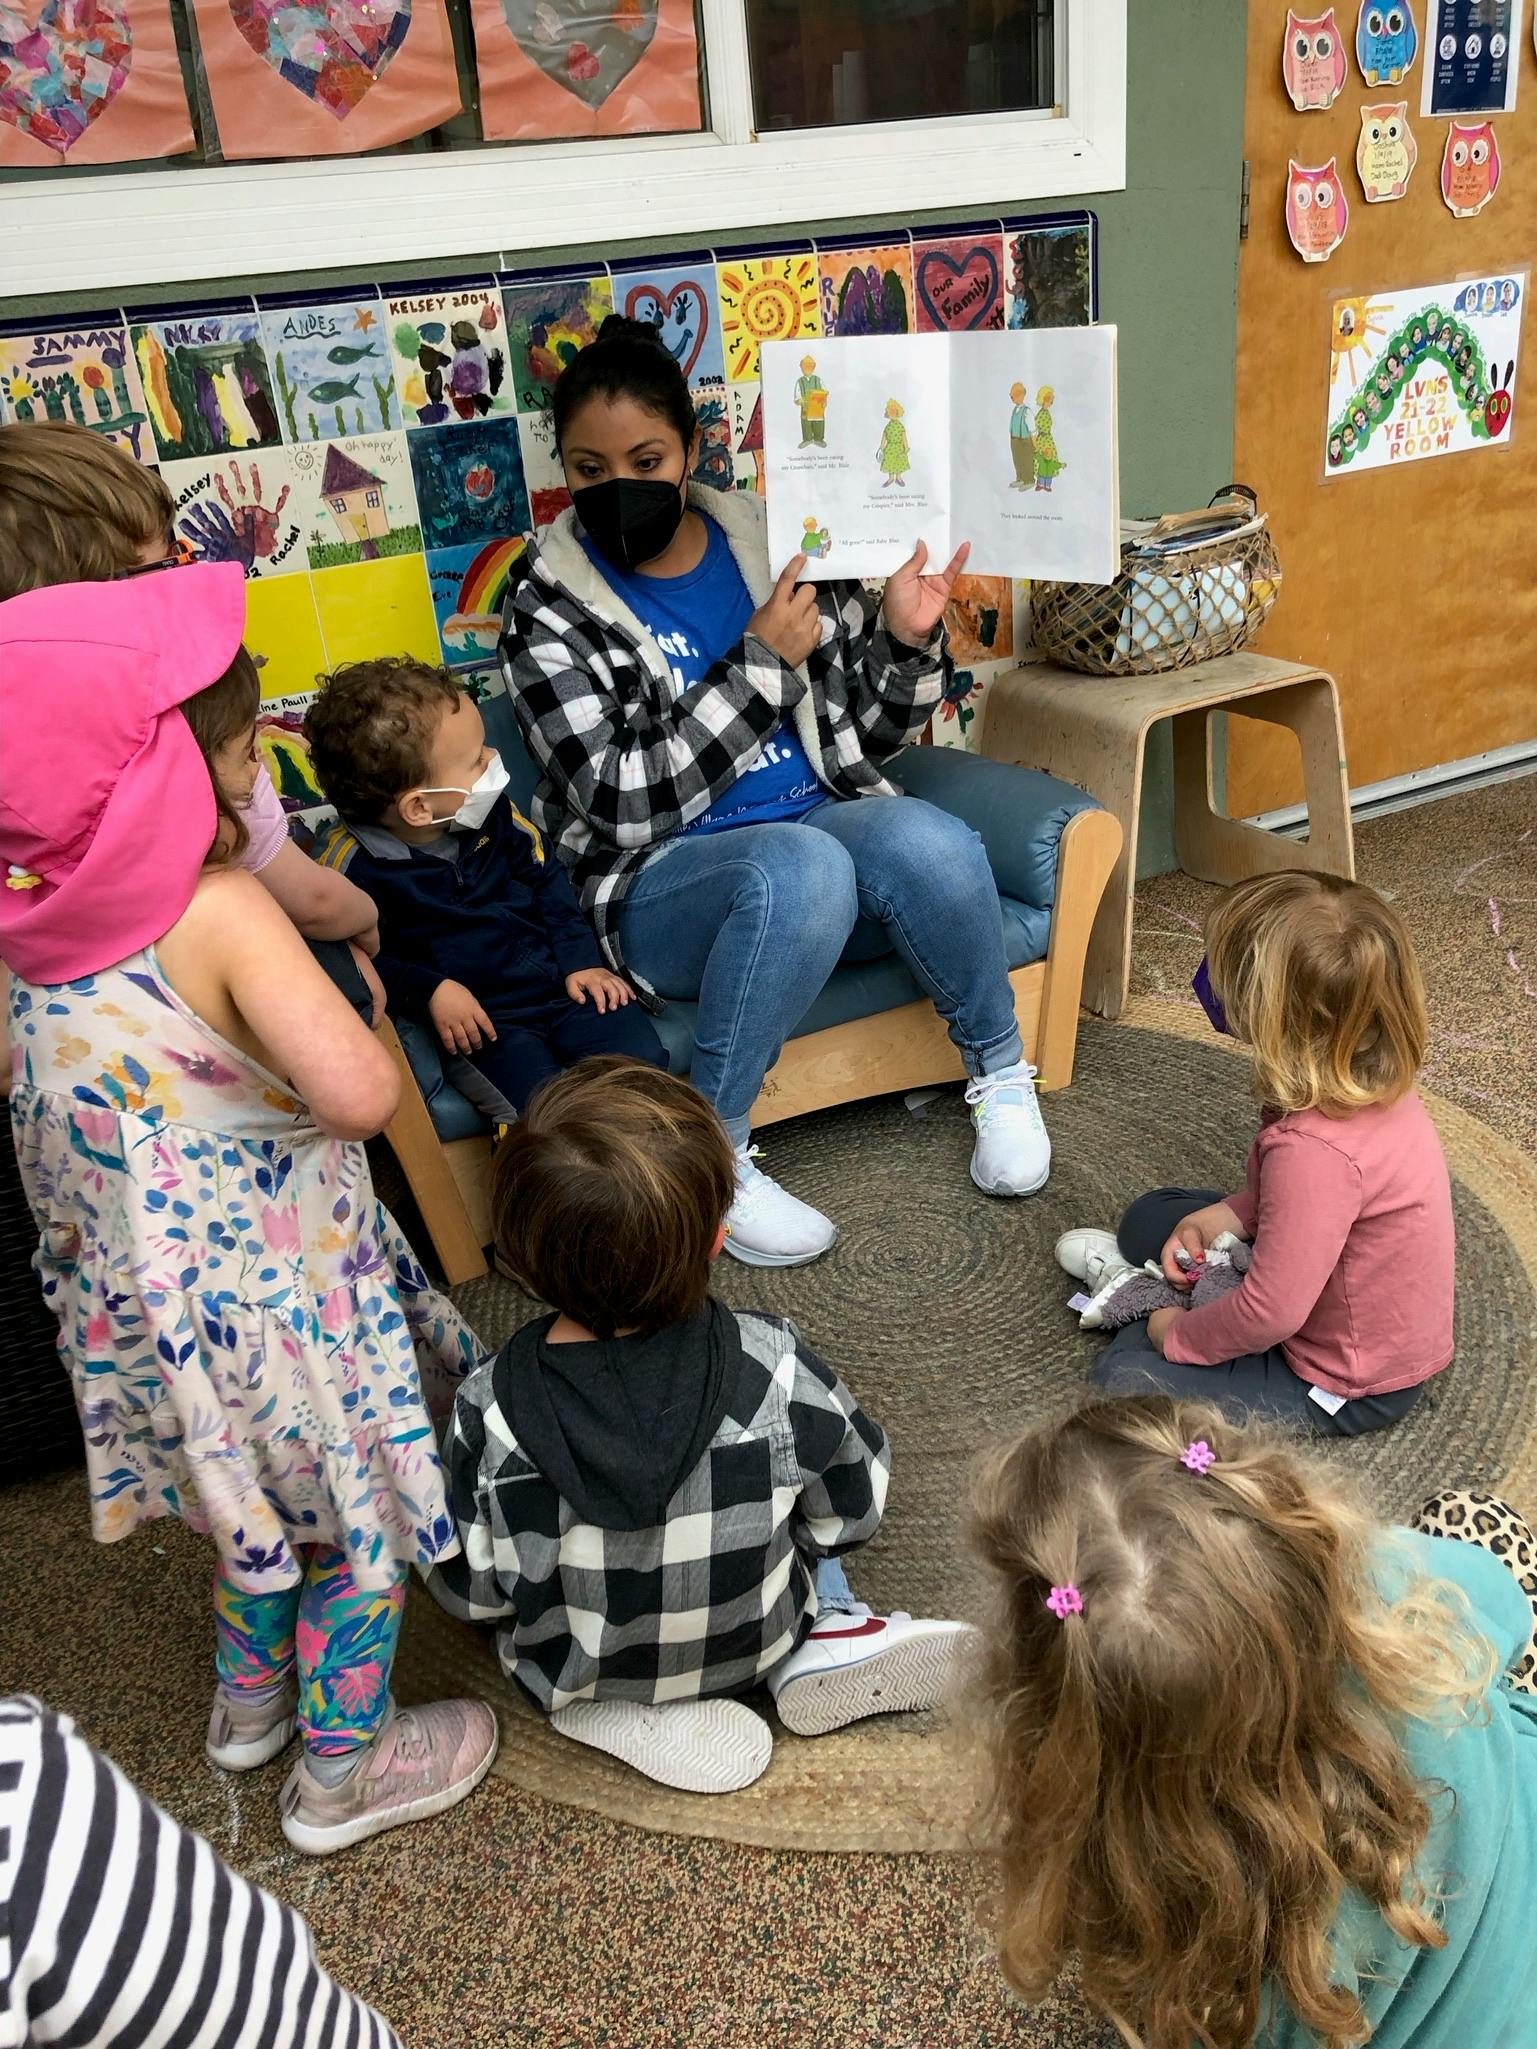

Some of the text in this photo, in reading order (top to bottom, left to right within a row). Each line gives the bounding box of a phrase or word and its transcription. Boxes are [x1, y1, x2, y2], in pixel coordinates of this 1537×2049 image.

[389, 292, 490, 316] KELSEY 2004
[941, 274, 990, 321] Family
[283, 314, 336, 334] ANDES
[32, 329, 127, 357] SAMMY
[698, 375, 725, 386] 2002
[1400, 396, 1447, 420] 21-22
[1384, 414, 1457, 441] YELLOW
[345, 441, 361, 452] Oh
[1390, 431, 1450, 459] ROOM
[270, 524, 301, 566] Rachel
[281, 695, 309, 709] Paull
